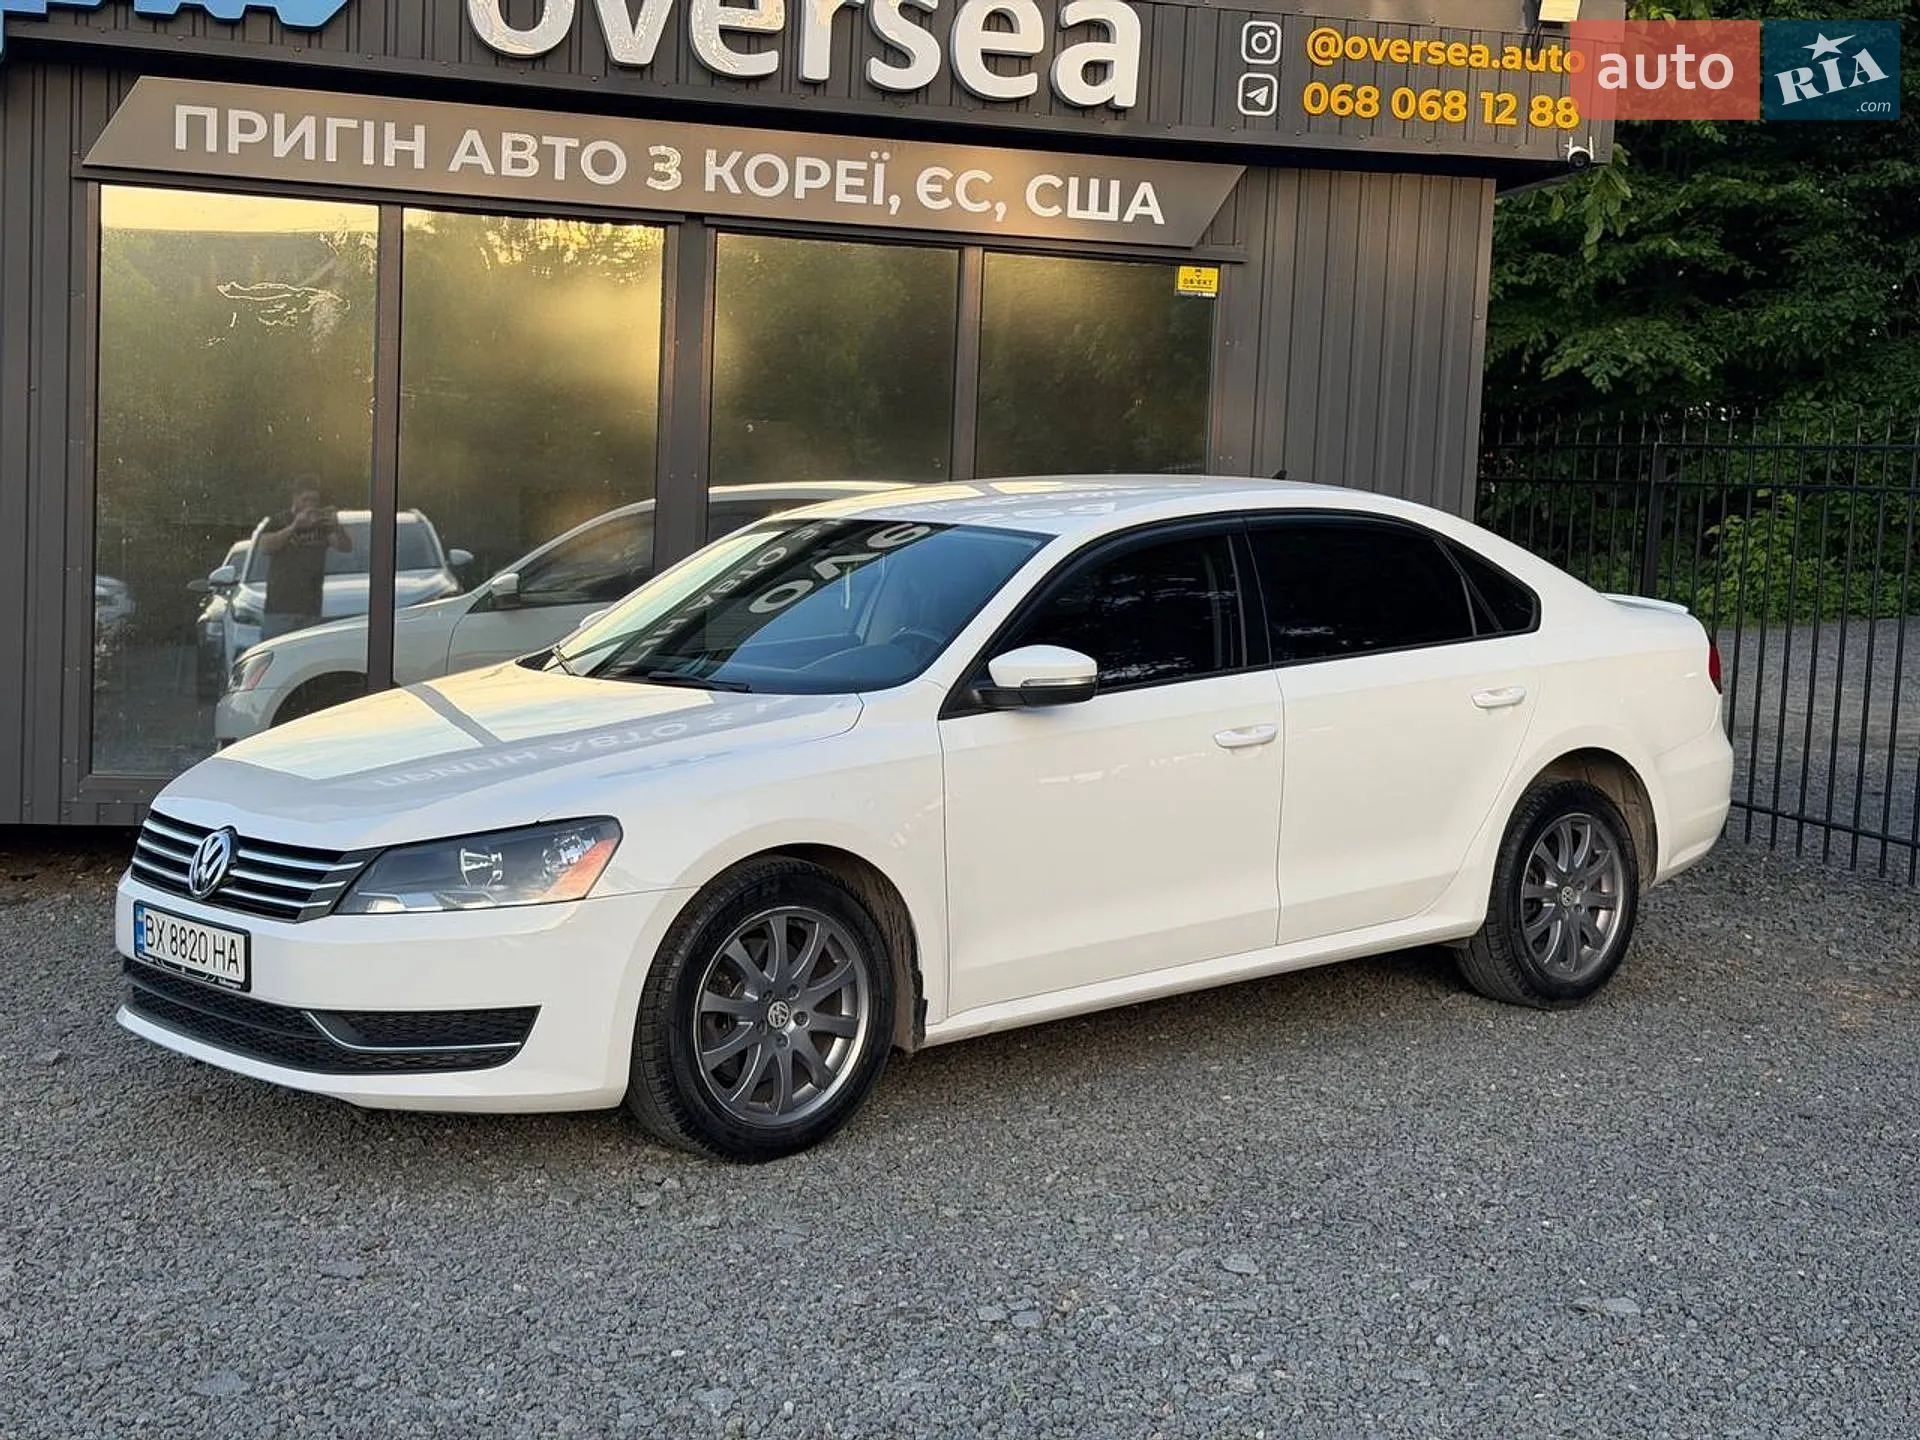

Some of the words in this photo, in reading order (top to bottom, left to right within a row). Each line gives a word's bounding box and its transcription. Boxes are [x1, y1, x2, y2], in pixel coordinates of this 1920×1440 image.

[1306, 26, 1586, 73] @oversea.auto
[1303, 81, 1380, 119] 068
[1391, 86, 1467, 122] 068
[1480, 91, 1518, 126] 12
[1529, 95, 1580, 130] 88
[174, 104, 426, 170] ПРИГІН
[447, 129, 628, 186] АВТО
[704, 148, 902, 215] КОРЕЇ,
[916, 166, 1007, 222] ЄС,
[1025, 173, 1166, 225] США
[145, 914, 166, 954] BX
[169, 923, 208, 965] 8820
[212, 934, 240, 974] HA
